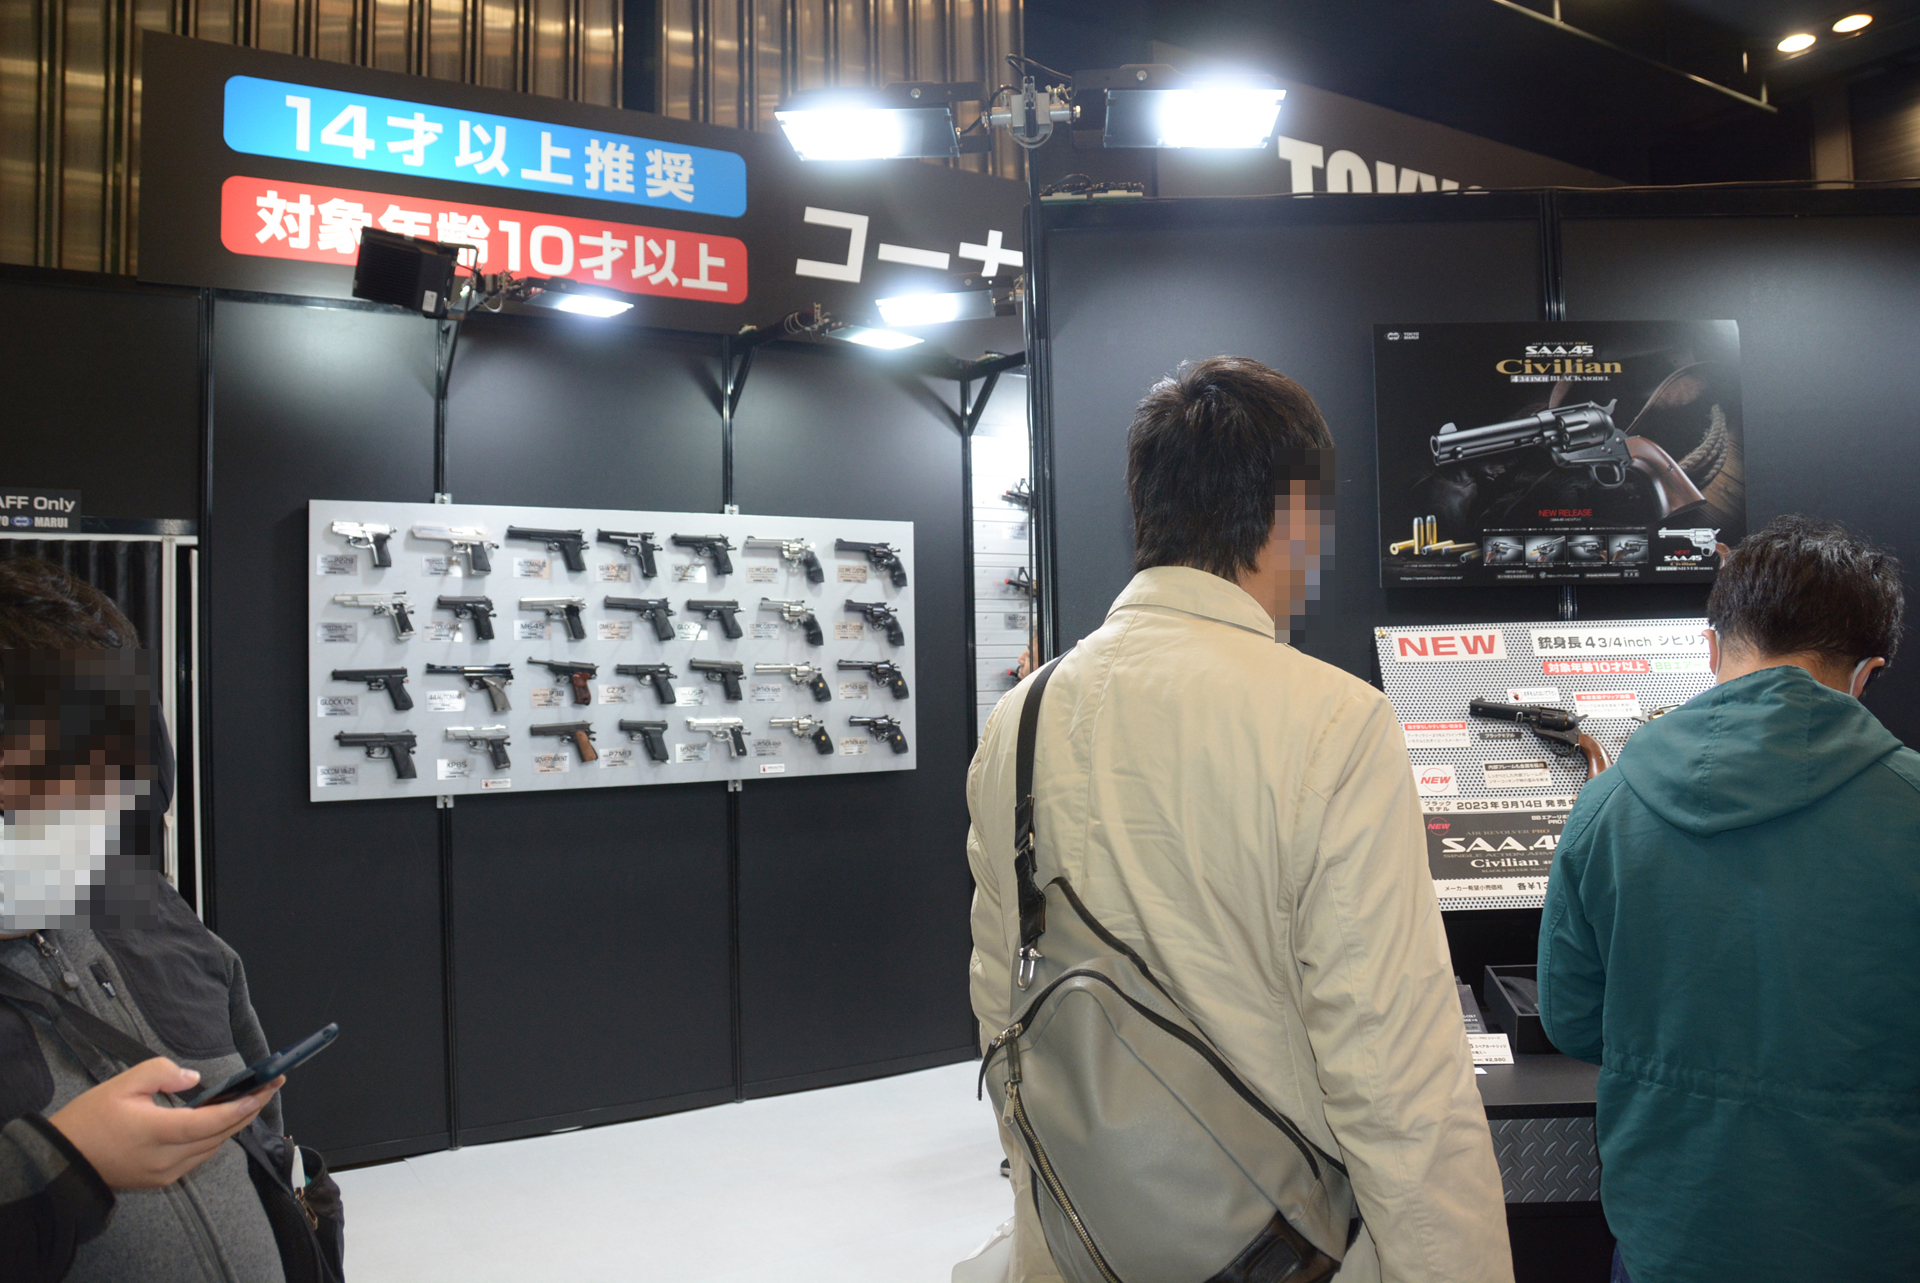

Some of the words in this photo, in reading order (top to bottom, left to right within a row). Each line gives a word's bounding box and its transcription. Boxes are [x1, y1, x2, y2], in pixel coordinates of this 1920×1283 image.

[285, 94, 696, 204] 14才以上推奨
[1496, 359, 1623, 375] Civilian
[34, 496, 76, 514] Only
[1539, 509, 1557, 517] NEW
[1558, 508, 1592, 517] RELEASE
[34, 516, 69, 528] MARUI
[1398, 634, 1495, 657] NEW
[1548, 661, 1646, 673] 対象年齢10才以上
[1420, 775, 1451, 785] NEW
[1428, 823, 1451, 831] NEW
[1470, 858, 1540, 868] Civilian
